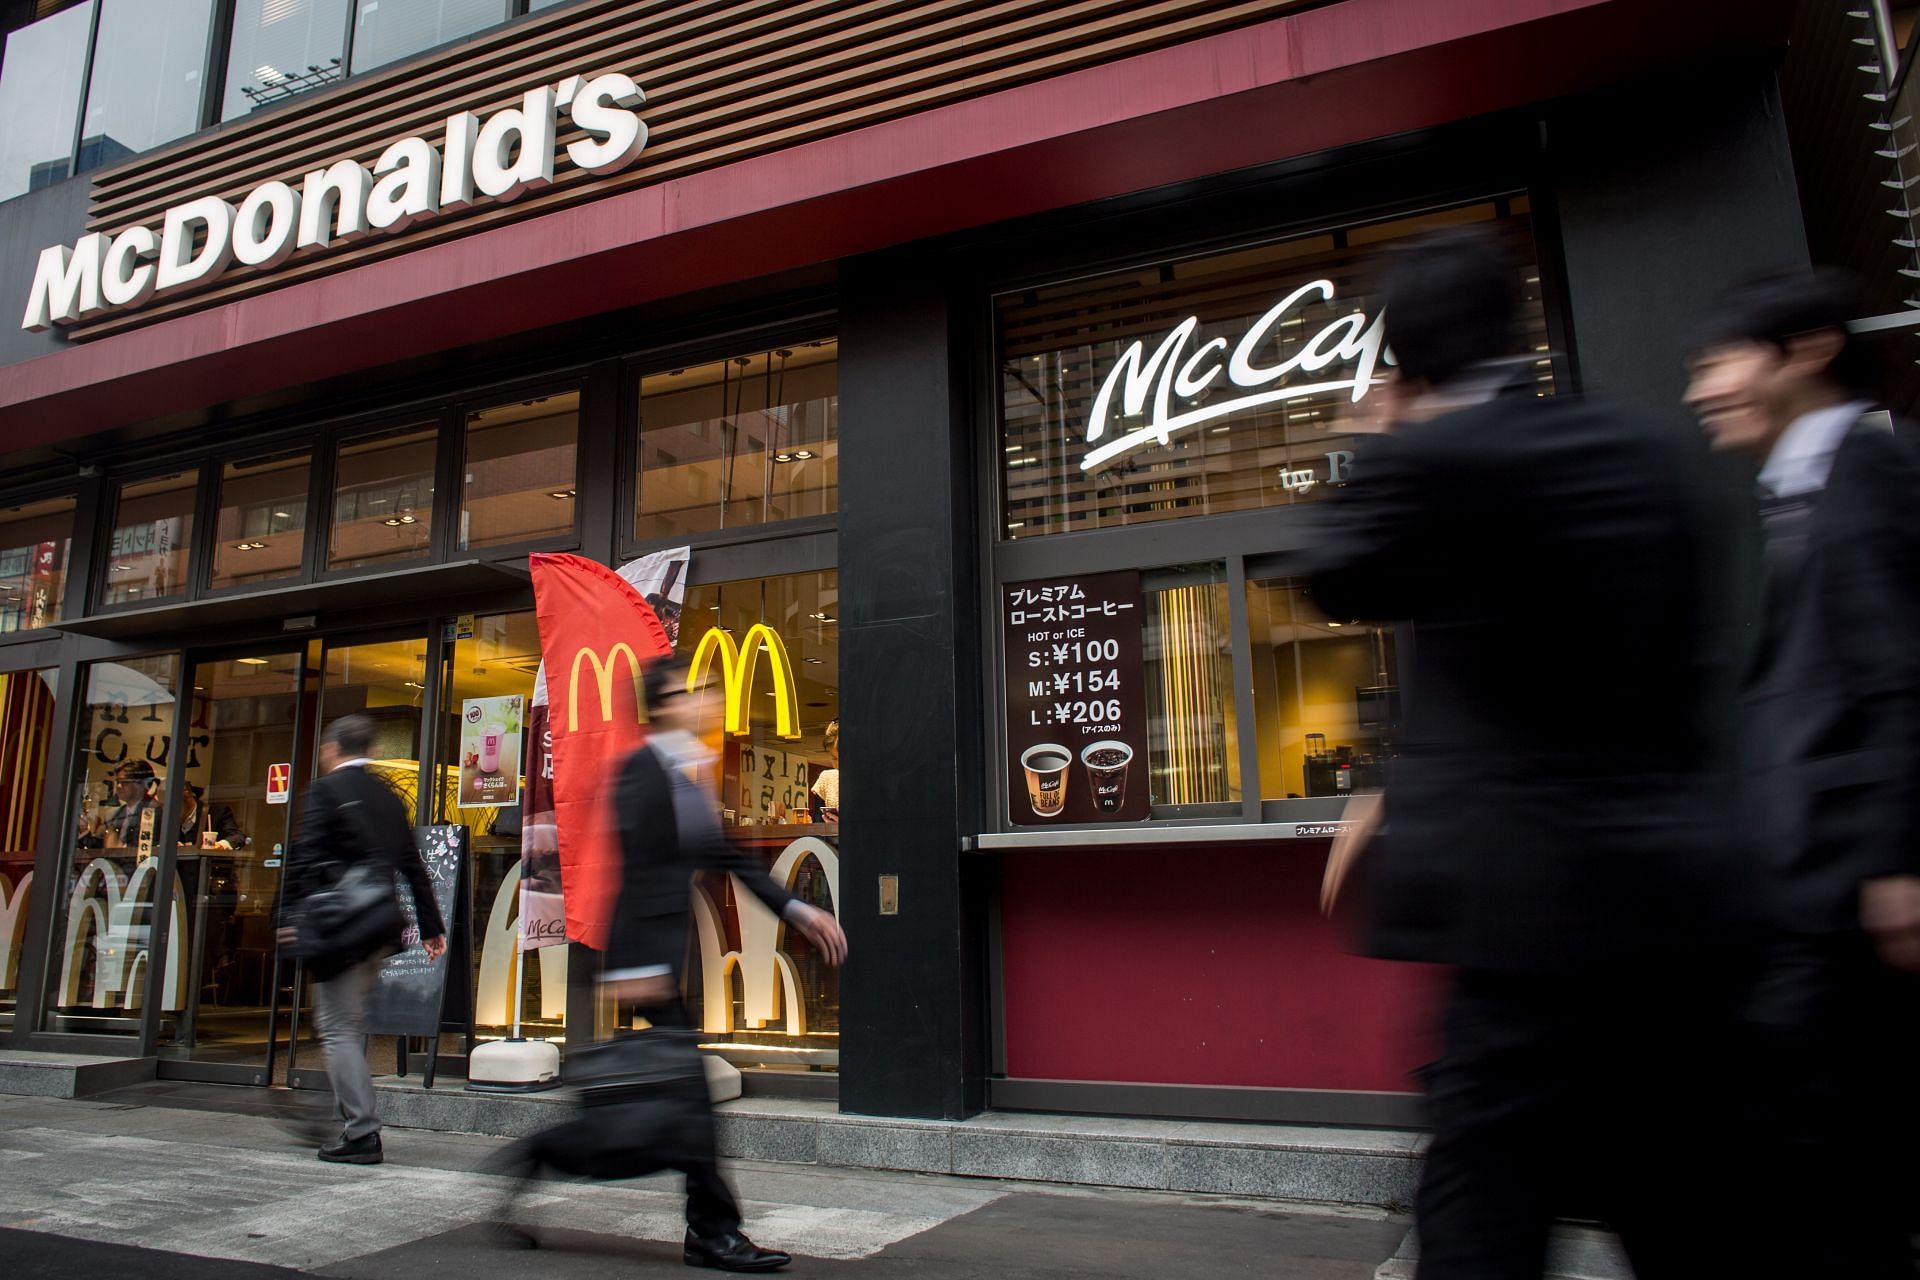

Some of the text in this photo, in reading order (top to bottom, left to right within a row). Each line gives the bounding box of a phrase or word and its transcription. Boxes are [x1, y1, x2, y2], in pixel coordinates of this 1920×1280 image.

[20, 72, 648, 334] McDonald's
[1081, 279, 1399, 471] McCaf
[1278, 467, 1315, 495] by
[1010, 584, 1085, 606] プレミアム
[1011, 601, 1134, 625] ローストコーヒー
[1027, 628, 1086, 643] HOT or ICE
[526, 918, 567, 941] McCa
